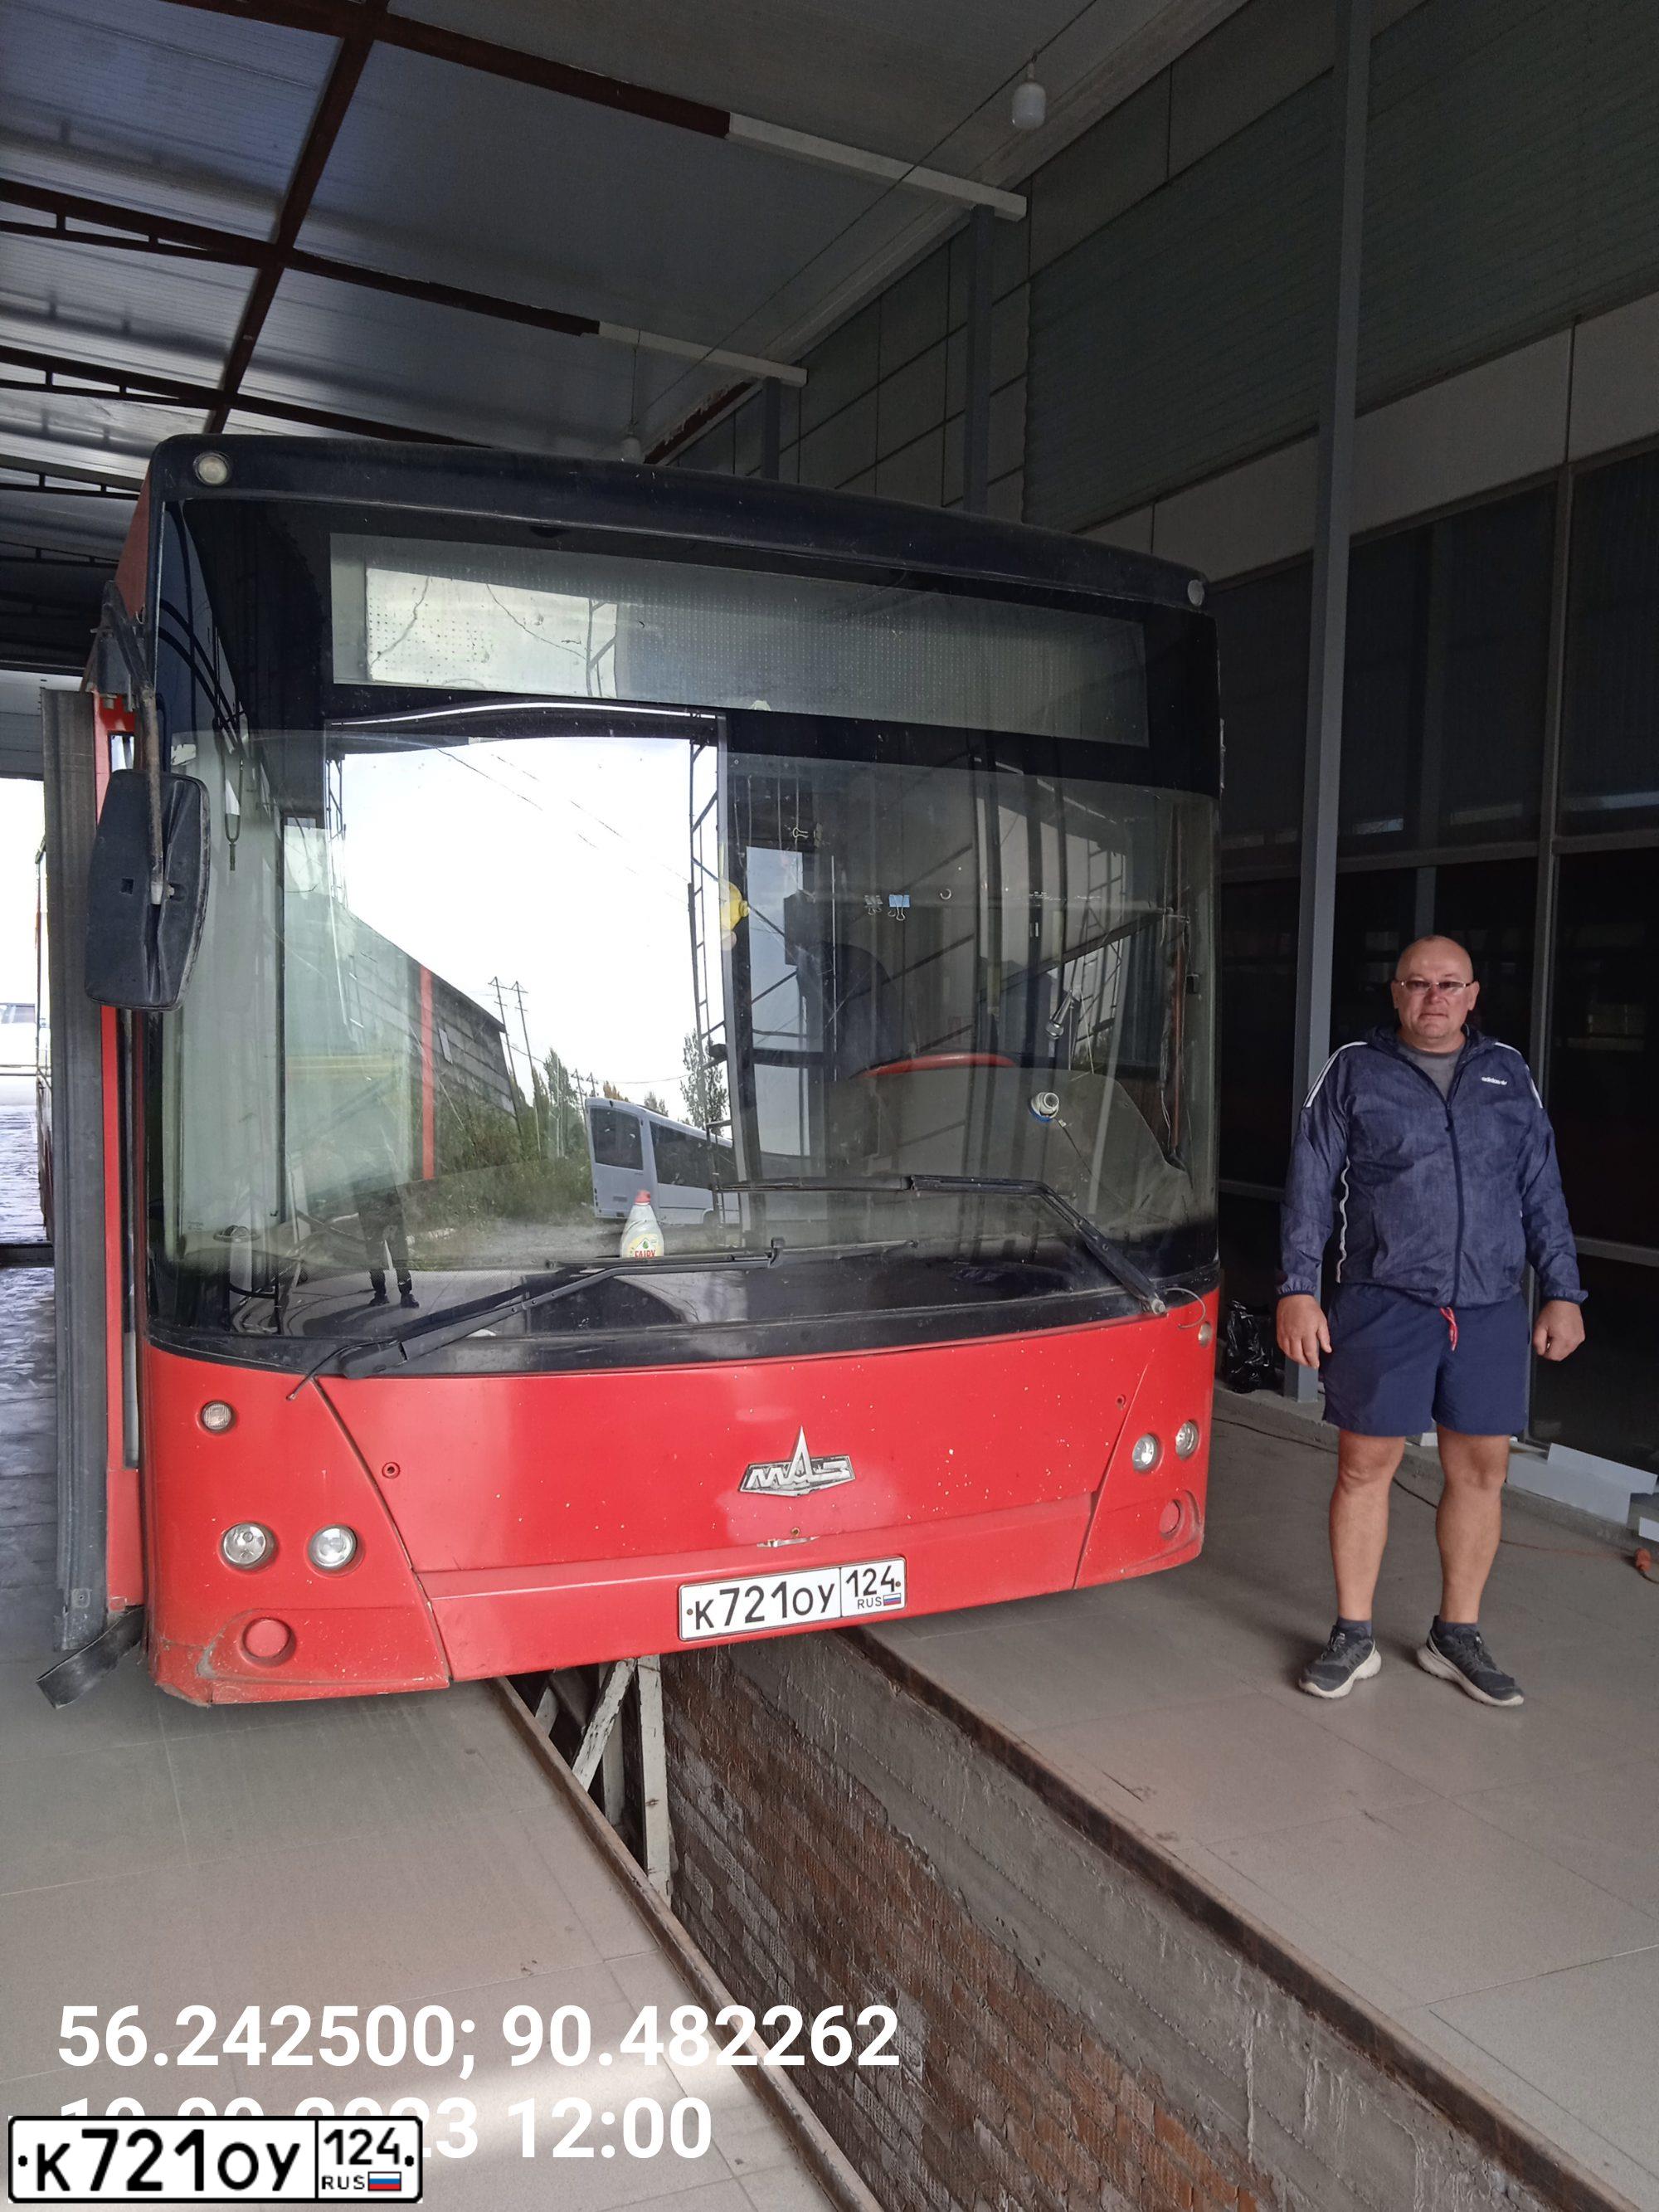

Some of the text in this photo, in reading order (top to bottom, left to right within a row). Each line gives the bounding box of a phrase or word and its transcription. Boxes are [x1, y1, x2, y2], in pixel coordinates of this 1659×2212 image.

[695, 1565, 896, 1630] К721ОУ 124
[857, 1596, 882, 1610] RUS
